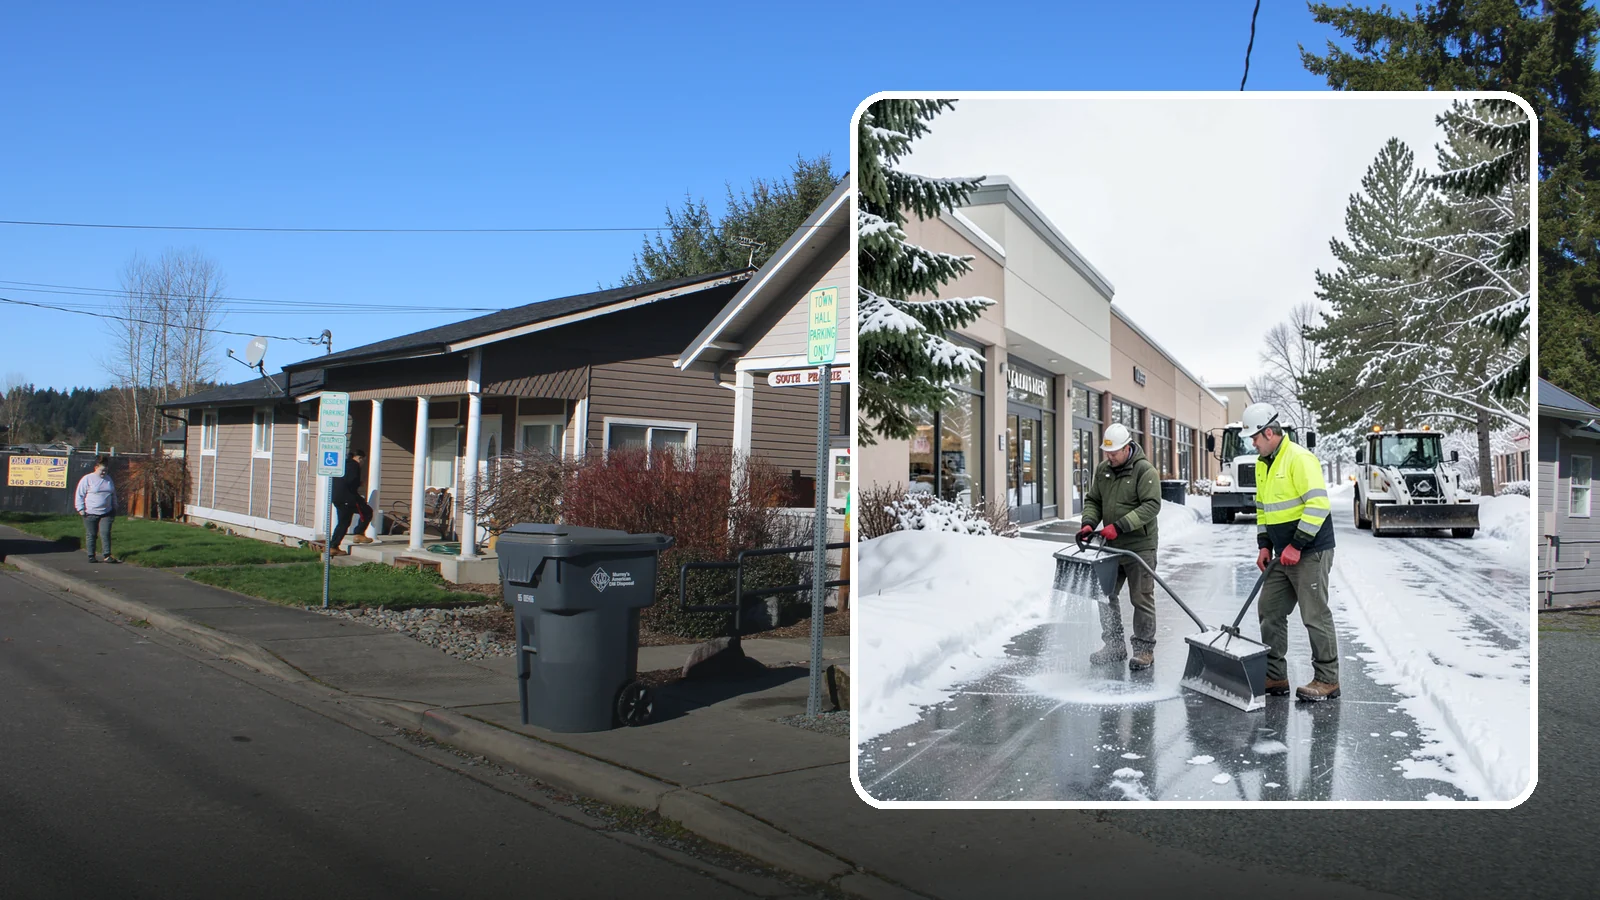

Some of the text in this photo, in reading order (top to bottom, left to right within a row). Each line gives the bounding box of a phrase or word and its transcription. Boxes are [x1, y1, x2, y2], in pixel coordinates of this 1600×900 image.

[815, 295, 832, 307] TOWN
[814, 311, 831, 324] HALL
[810, 326, 836, 340] PARKING
[813, 344, 831, 357] ONLY
[775, 373, 801, 384] SOUTH
[322, 409, 345, 417] PARKING
[325, 420, 340, 428] ONLY
